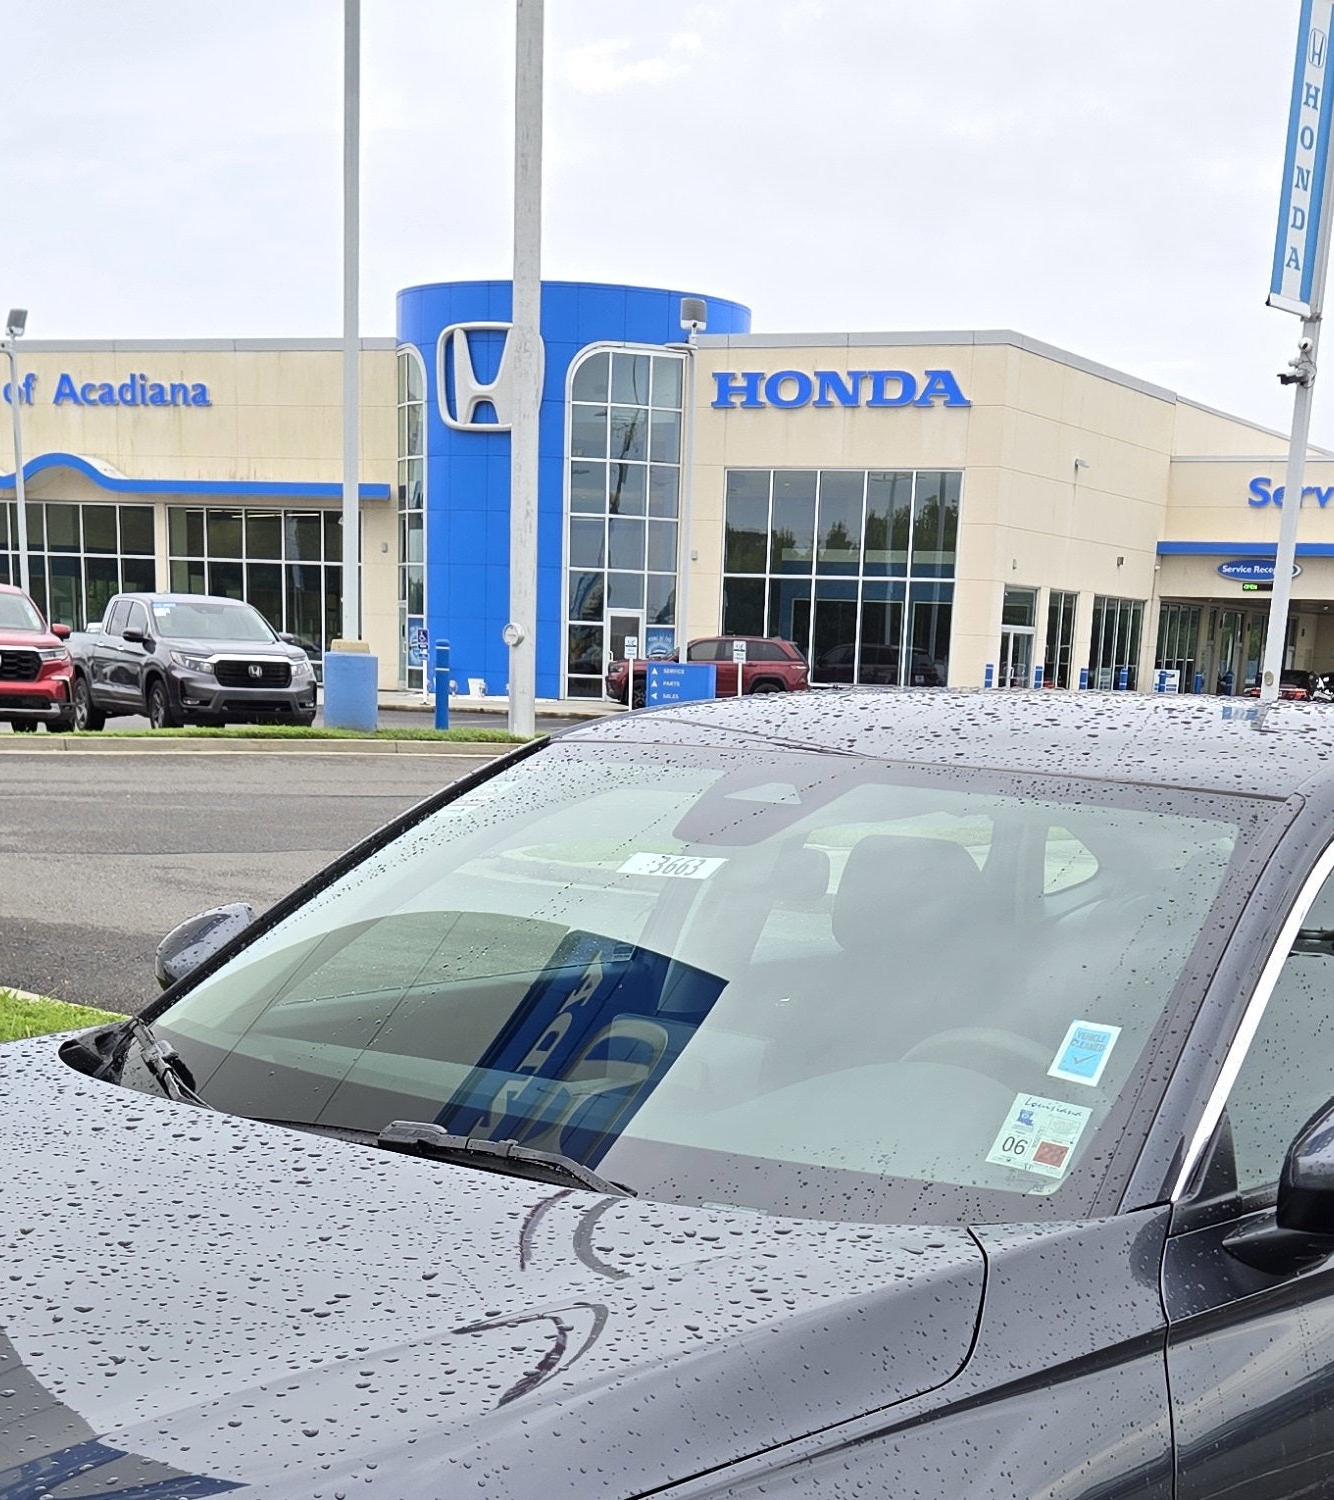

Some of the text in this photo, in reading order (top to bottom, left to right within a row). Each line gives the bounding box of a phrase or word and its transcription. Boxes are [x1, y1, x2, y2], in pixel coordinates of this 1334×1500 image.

[1285, 82, 1321, 272] HONDA
[3, 373, 37, 406] of
[53, 373, 212, 407] Acadiana
[711, 370, 971, 409] HONDA
[1222, 564, 1252, 573] Service
[648, 855, 707, 877] 3663
[1002, 1135, 1028, 1155] 06
